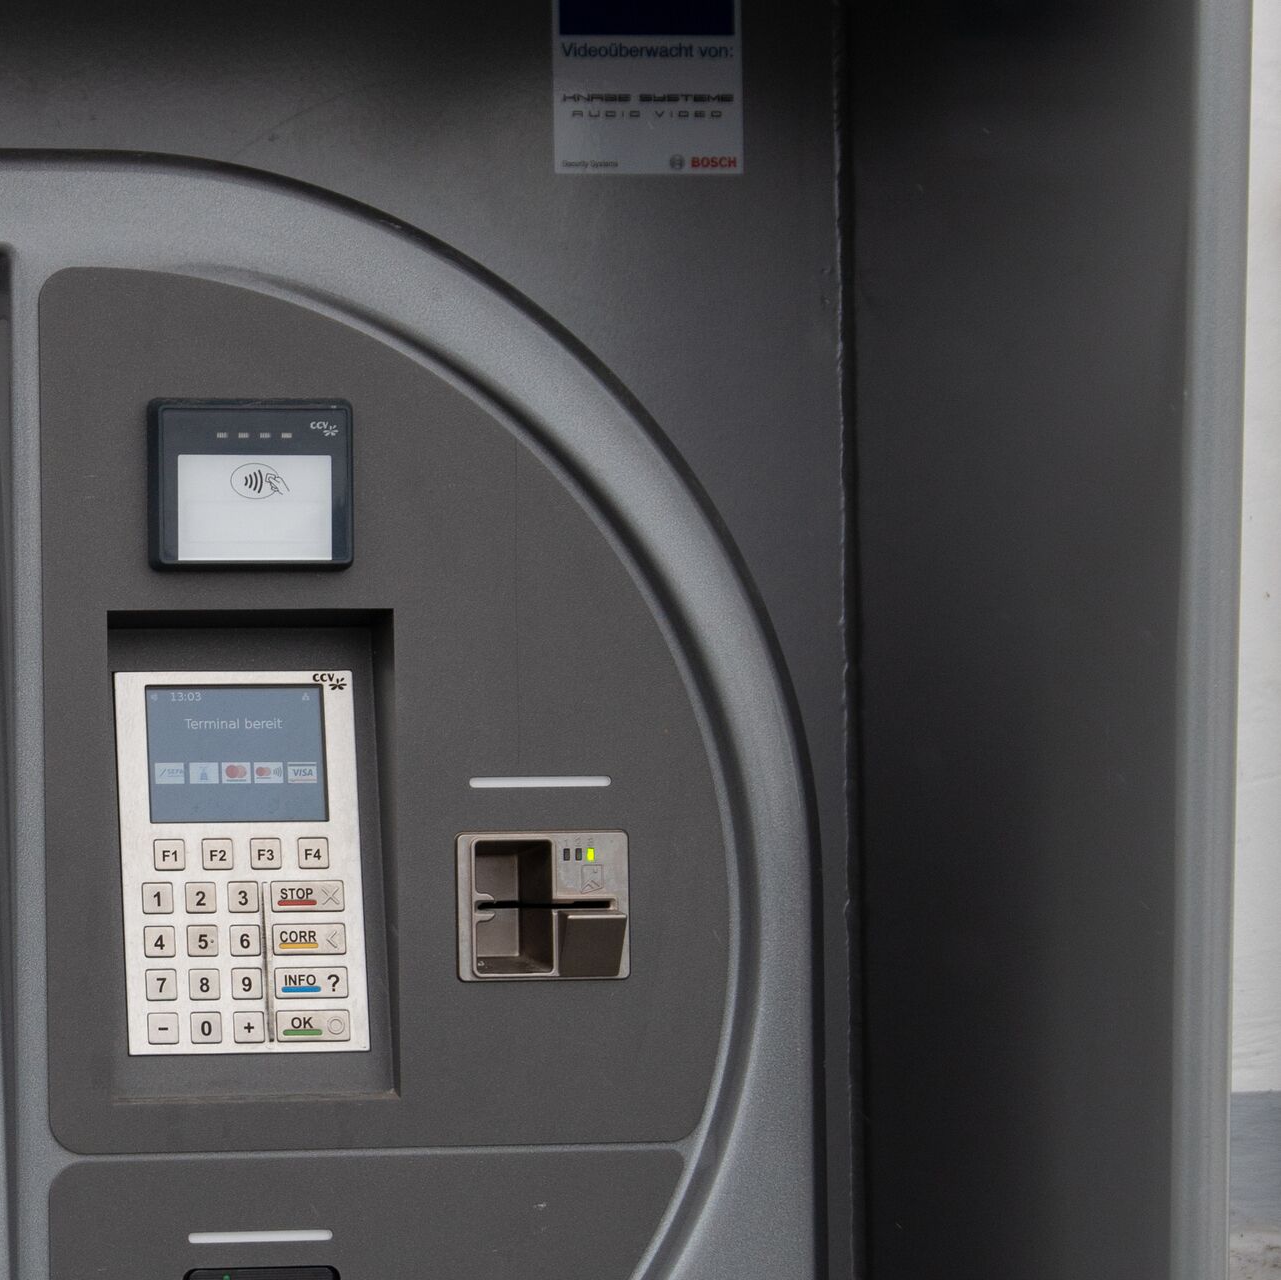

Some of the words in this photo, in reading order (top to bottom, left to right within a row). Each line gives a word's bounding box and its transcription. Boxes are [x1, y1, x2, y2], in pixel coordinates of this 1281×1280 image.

[561, 42, 695, 58] Videoüberwacht
[698, 45, 734, 58] von:
[639, 93, 735, 103] SYSTEME
[572, 110, 640, 118] AUDIO
[654, 110, 723, 118] VIDEO
[690, 156, 737, 168] BOSCH
[310, 421, 329, 430] CCV
[312, 673, 335, 682] CCV
[170, 692, 202, 702] 13:03
[184, 718, 240, 730] Terminal
[244, 718, 283, 730] bereit
[162, 850, 178, 862] F1
[210, 850, 227, 862] F2
[257, 849, 275, 861] F3
[304, 848, 322, 861] F4
[153, 891, 162, 907] 1
[195, 891, 207, 906] 2
[238, 890, 249, 906] 3
[280, 888, 314, 900] STOP
[154, 934, 165, 950] 4
[198, 934, 208, 950] 5
[239, 933, 250, 949] 6
[279, 930, 317, 943] CORR
[156, 977, 167, 993] 7
[199, 977, 210, 993] 8
[241, 977, 252, 992] 9
[284, 974, 317, 986] INFO
[327, 974, 340, 992] ?
[201, 1021, 212, 1036] 0
[290, 1016, 314, 1029] OK
